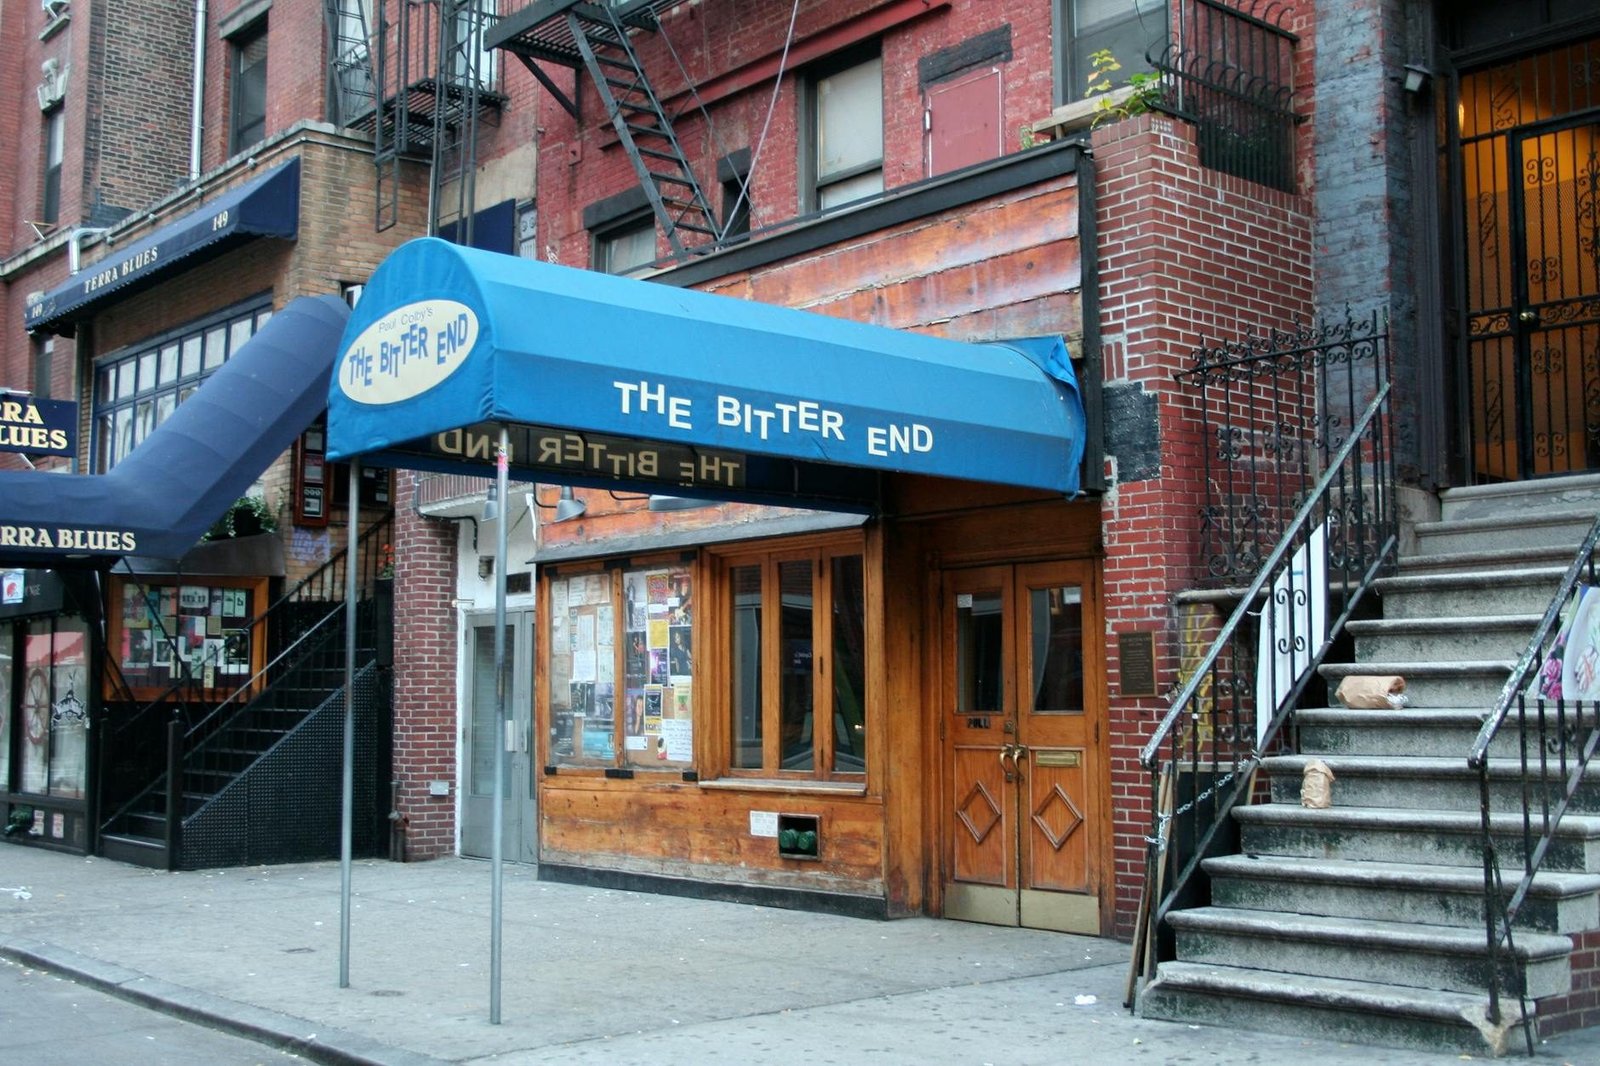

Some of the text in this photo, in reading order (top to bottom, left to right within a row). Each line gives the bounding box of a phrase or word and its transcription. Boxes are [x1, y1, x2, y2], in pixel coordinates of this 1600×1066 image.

[211, 210, 229, 231] 149
[84, 247, 158, 293] TERRA BLUES
[378, 307, 433, 333] Paul Colby's
[349, 313, 468, 387] THE BITTER END
[0, 401, 44, 424] RA
[613, 381, 933, 457] THE BITTER END
[0, 525, 136, 551] RRA BLUES
